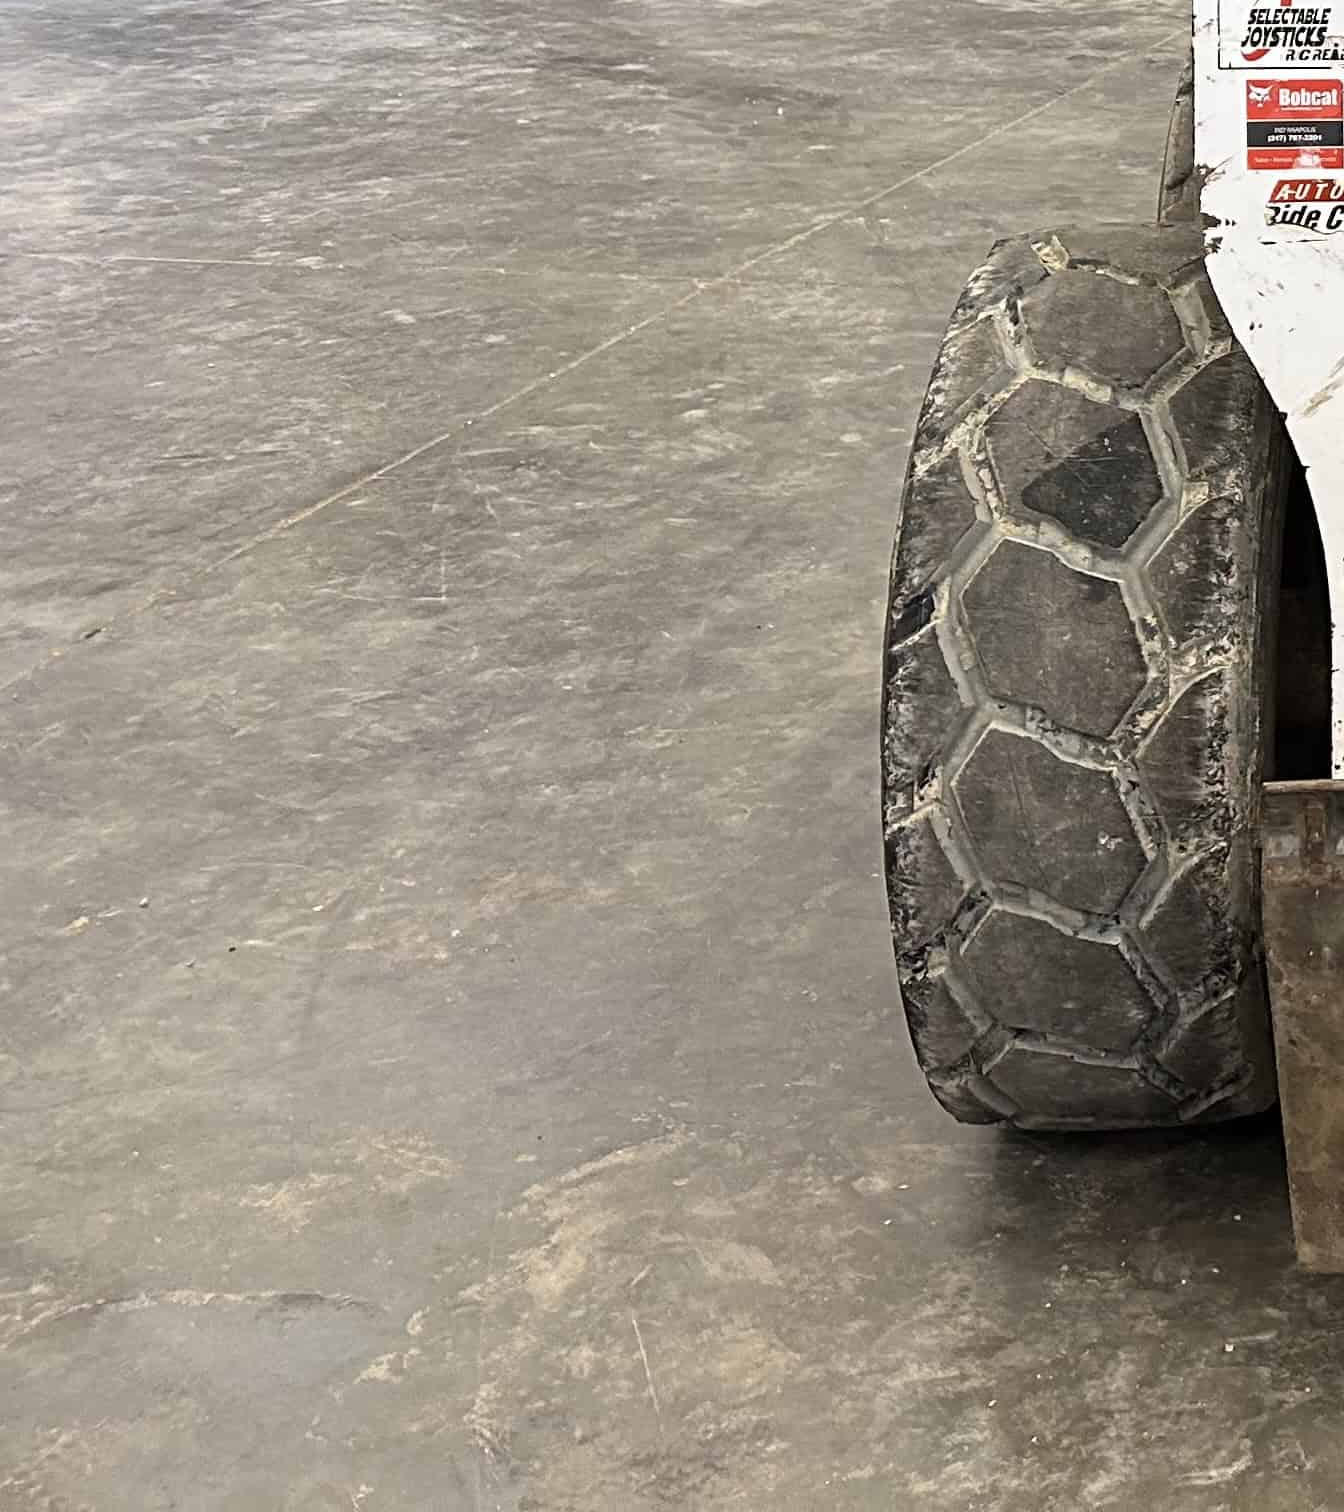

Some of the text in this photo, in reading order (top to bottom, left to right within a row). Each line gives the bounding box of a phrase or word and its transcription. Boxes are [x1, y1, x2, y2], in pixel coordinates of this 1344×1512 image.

[1247, 7, 1332, 25] SELECTABLE
[1240, 26, 1329, 47] JOYSTICKS
[1279, 88, 1338, 106] Bobcat
